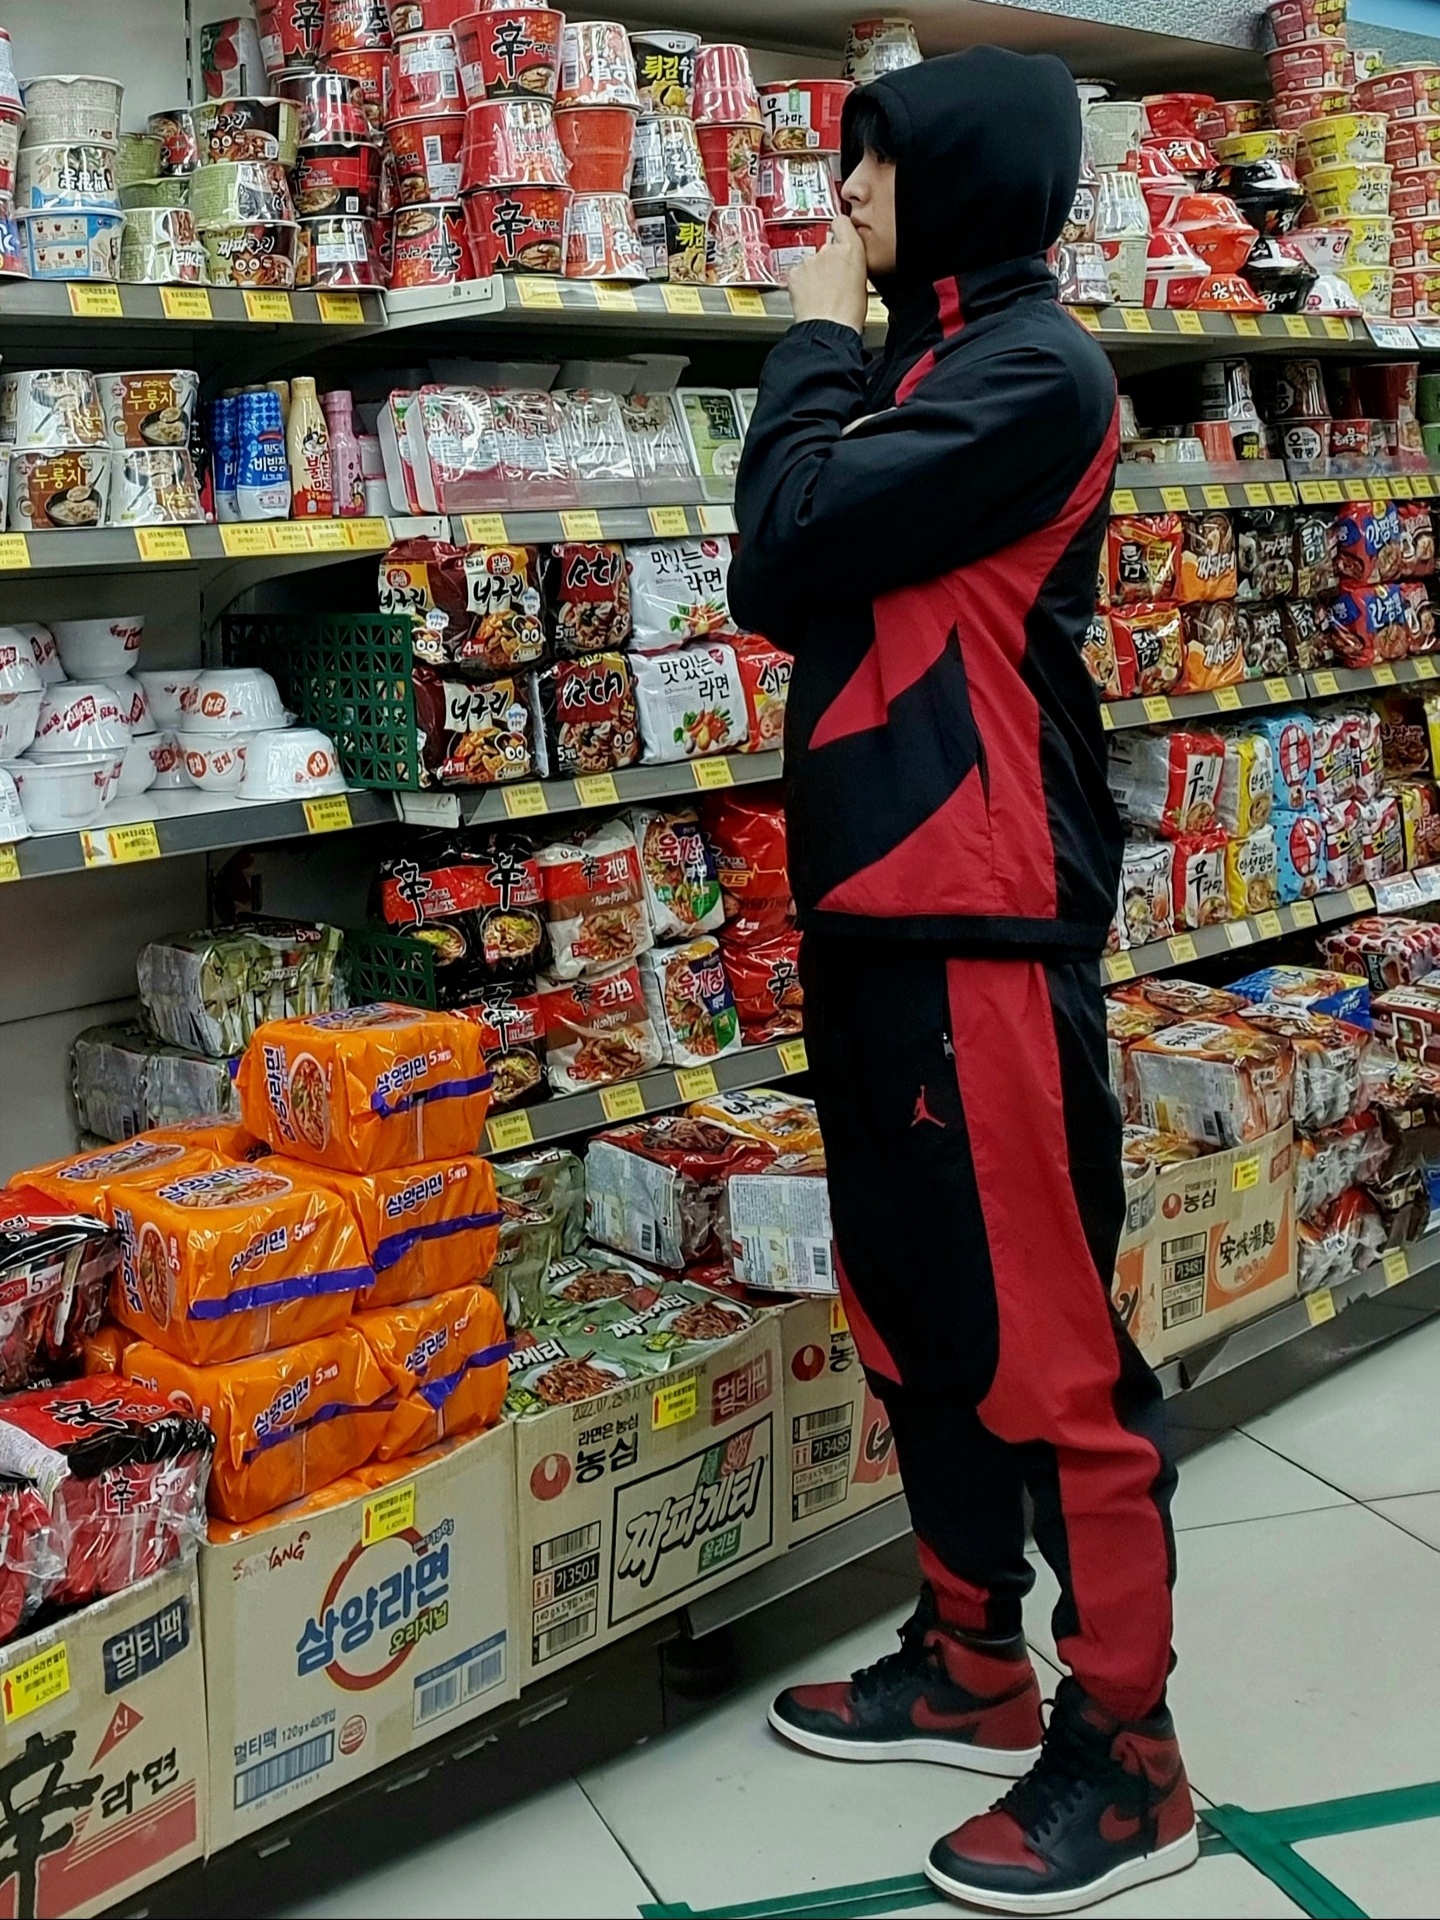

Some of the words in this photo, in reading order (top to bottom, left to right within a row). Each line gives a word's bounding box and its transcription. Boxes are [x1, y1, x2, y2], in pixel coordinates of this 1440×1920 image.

[492, 19, 533, 79] 辛
[491, 198, 535, 257] 辛
[126, 389, 174, 410] 누룽지
[32, 468, 82, 489] 누룽지
[253, 456, 287, 473] 비빔장
[473, 575, 525, 605] 너구리
[683, 568, 724, 595] 라면
[659, 655, 711, 686] 맛있는
[699, 671, 731, 703] 라면
[450, 690, 509, 723] 너구리
[212, 750, 234, 775] 김치
[486, 852, 529, 912] 辛
[603, 854, 631, 885] 건면
[393, 858, 433, 927] 辛
[598, 979, 635, 1007] 건면
[374, 1053, 428, 1097] 삼양라면
[262, 1044, 298, 1144] 삼양라면
[385, 1172, 444, 1218] 삼양라면
[1184, 1189, 1217, 1214] 농심
[253, 1375, 311, 1438] 삼양라면
[578, 1422, 614, 1447] 라면은
[615, 1413, 639, 1435] 농심
[813, 1432, 850, 1458] 가3489
[575, 1431, 639, 1484] 농심
[109, 1475, 137, 1516] 辛
[617, 1453, 769, 1589] 짜파게티
[699, 1527, 739, 1567] 올리브
[555, 1560, 598, 1593] 가3501
[296, 1546, 450, 1678] 삼양라면
[388, 1600, 450, 1656] 오리지널
[535, 1610, 550, 1624] 140
[111, 1606, 184, 1681] 멀티팩
[113, 1708, 129, 1739] 신
[233, 1726, 278, 1767] 멀티팩
[101, 1745, 180, 1820] 라면
